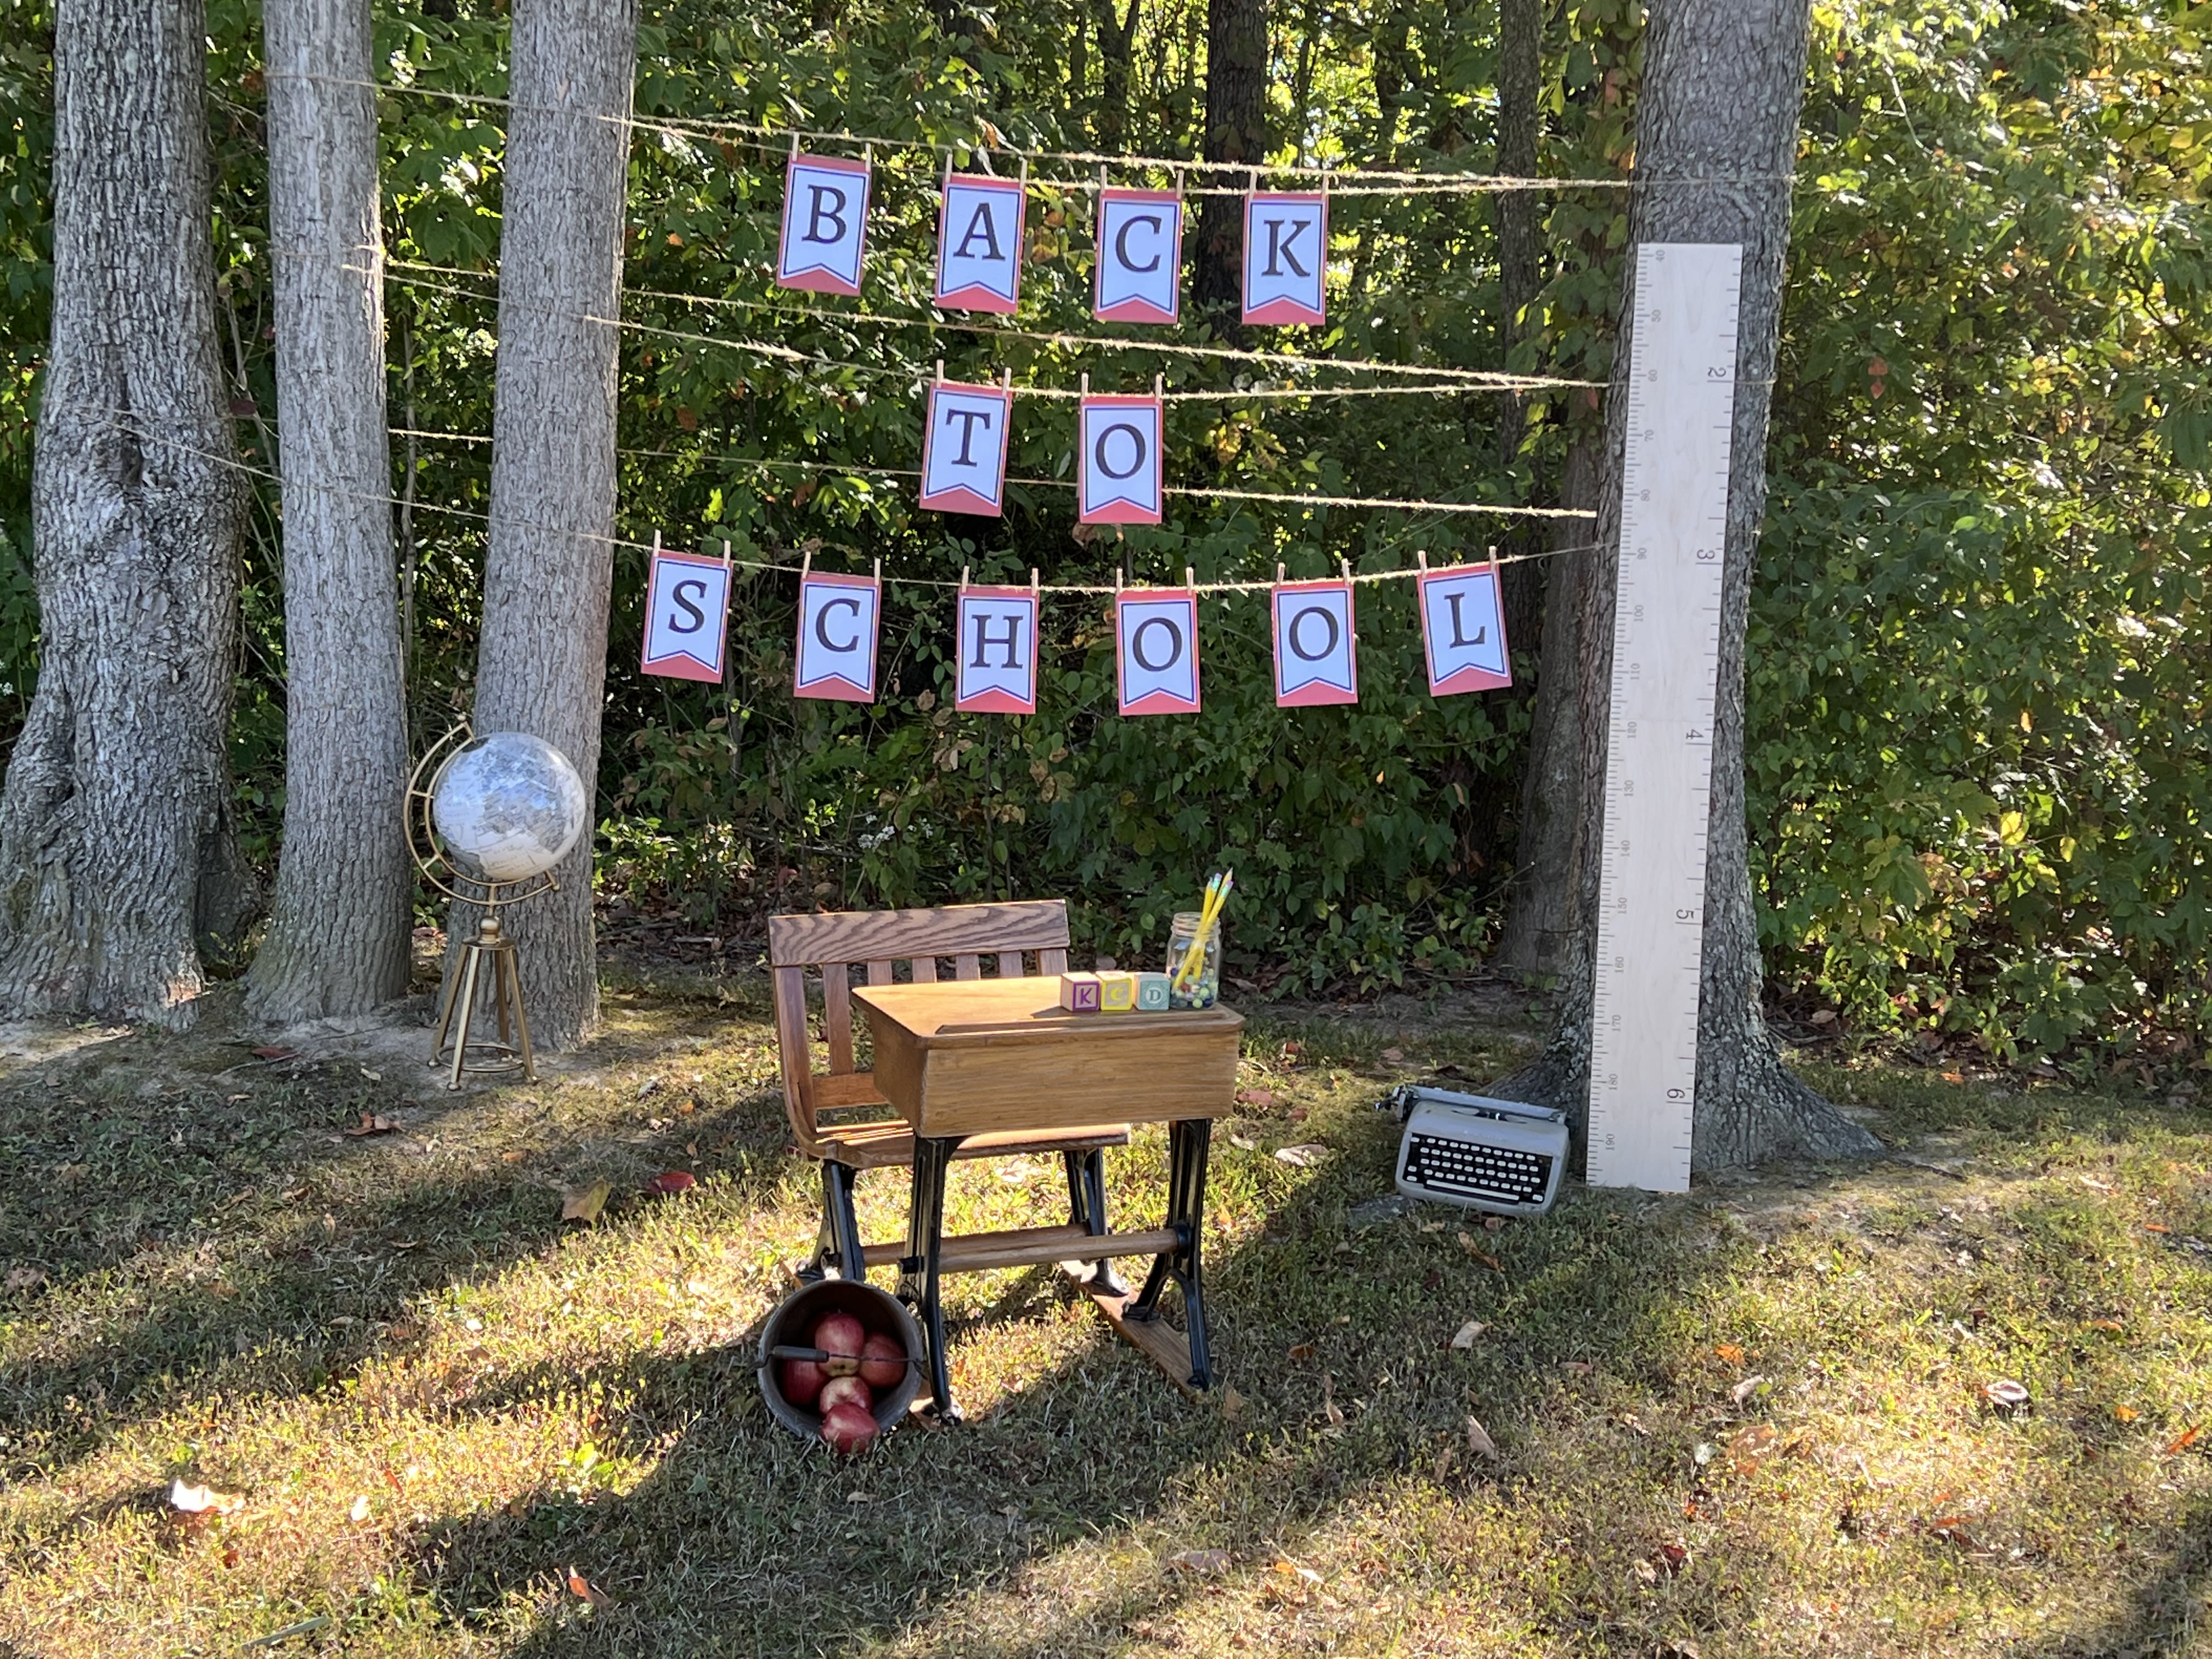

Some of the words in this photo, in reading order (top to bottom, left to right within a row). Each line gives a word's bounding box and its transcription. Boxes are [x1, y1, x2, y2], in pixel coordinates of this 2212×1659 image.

[1655, 250, 1666, 262] 40
[1651, 309, 1661, 323] 50
[1648, 369, 1658, 382] 60
[1707, 366, 1726, 377] 2
[1644, 430, 1654, 442] 70
[1640, 489, 1650, 501] 80
[1637, 548, 1647, 560] 90
[1697, 549, 1715, 560] 3
[1634, 605, 1644, 622] 100
[1630, 663, 1640, 680] 110
[1627, 721, 1637, 738] 120
[1686, 729, 1704, 740] 4
[1624, 780, 1634, 797] 130
[1621, 840, 1630, 857] 140
[1618, 897, 1627, 915] 150
[1676, 909, 1695, 919] 5
[1615, 956, 1624, 973] 160
[1080, 988, 1093, 1005] K
[1110, 988, 1124, 1001] C
[1149, 989, 1162, 1002] D
[1612, 1014, 1621, 1031] 170
[1609, 1074, 1618, 1090] 180
[1667, 1088, 1685, 1098] 6
[1605, 1133, 1615, 1150] 190
